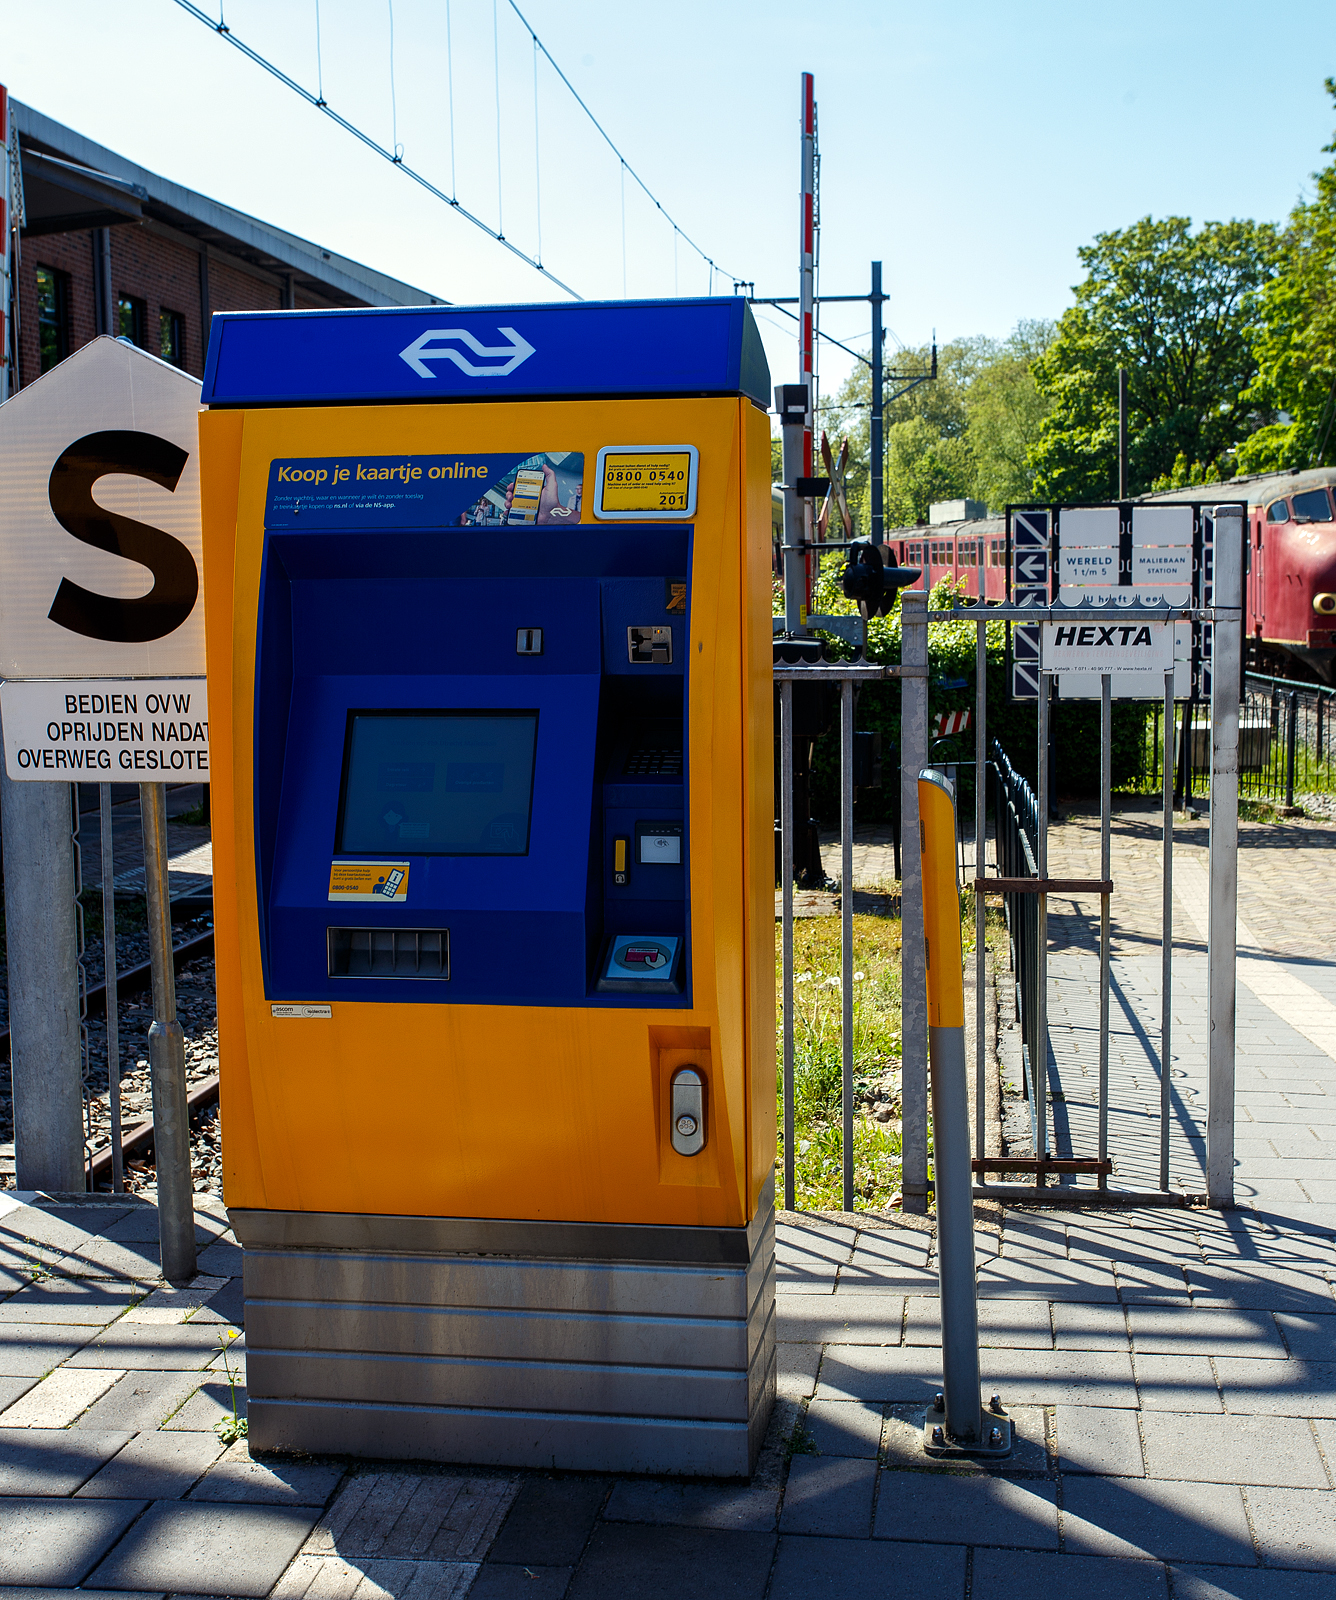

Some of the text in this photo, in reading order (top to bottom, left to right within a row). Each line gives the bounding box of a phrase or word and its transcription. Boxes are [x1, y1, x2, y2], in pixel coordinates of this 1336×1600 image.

[278, 462, 488, 485] Koop je kaartje online
[607, 470, 684, 481] 0800 0540
[659, 495, 684, 505] 201
[48, 429, 198, 643] S
[1066, 556, 1113, 566] WERELD
[1073, 567, 1107, 577] 1 t/m 5
[1086, 595, 1094, 603] U
[1054, 626, 1152, 646] HEXTA
[1054, 650, 1085, 658] HEKWERK
[65, 694, 191, 714] BEDIEN OVW
[47, 722, 144, 742] OPRIJDEN
[17, 749, 111, 769] OVERWEG
